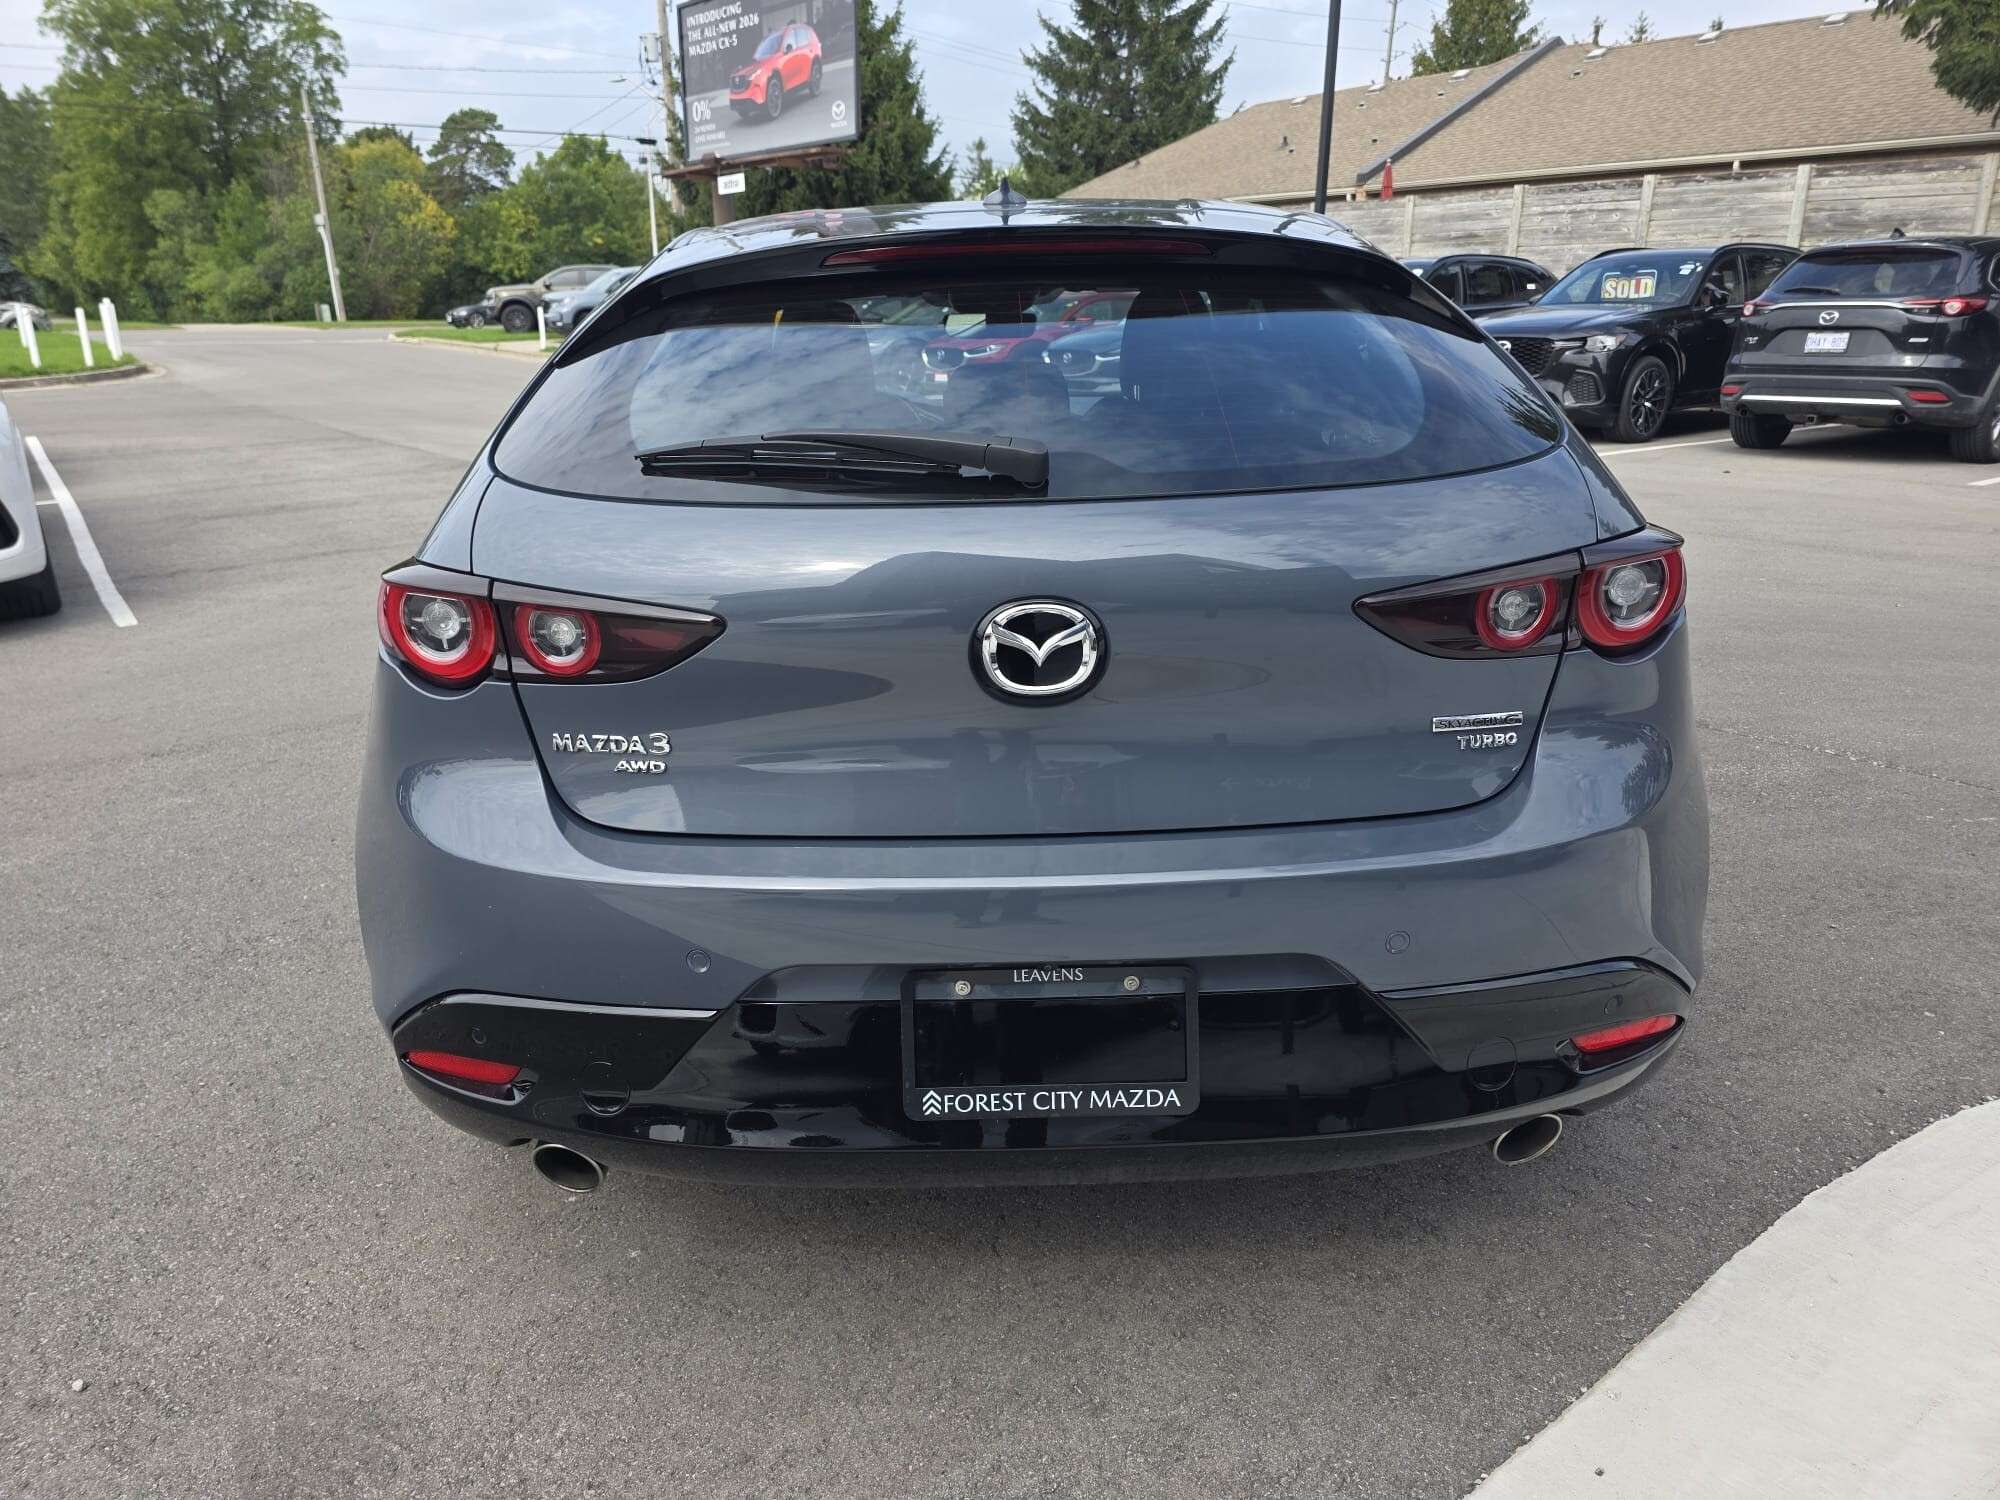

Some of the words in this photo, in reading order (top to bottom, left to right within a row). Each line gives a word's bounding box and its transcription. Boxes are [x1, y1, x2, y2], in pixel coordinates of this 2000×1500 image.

[686, 1, 742, 28] INTRODUCING
[687, 28, 702, 43] THE
[703, 20, 737, 38] ALL-NEW
[739, 12, 760, 29] 2026
[688, 40, 717, 57] MAZDA
[718, 33, 738, 50] CX-5
[692, 99, 711, 122] 0%
[1602, 276, 1655, 300] SOLD
[1456, 732, 1518, 750] TURBO
[613, 759, 667, 774] AWD
[1013, 967, 1084, 983] LEAVENS
[943, 1091, 1027, 1114] FOREST
[1032, 1090, 1083, 1111] CITY
[1089, 1088, 1182, 1109] MAZDA
